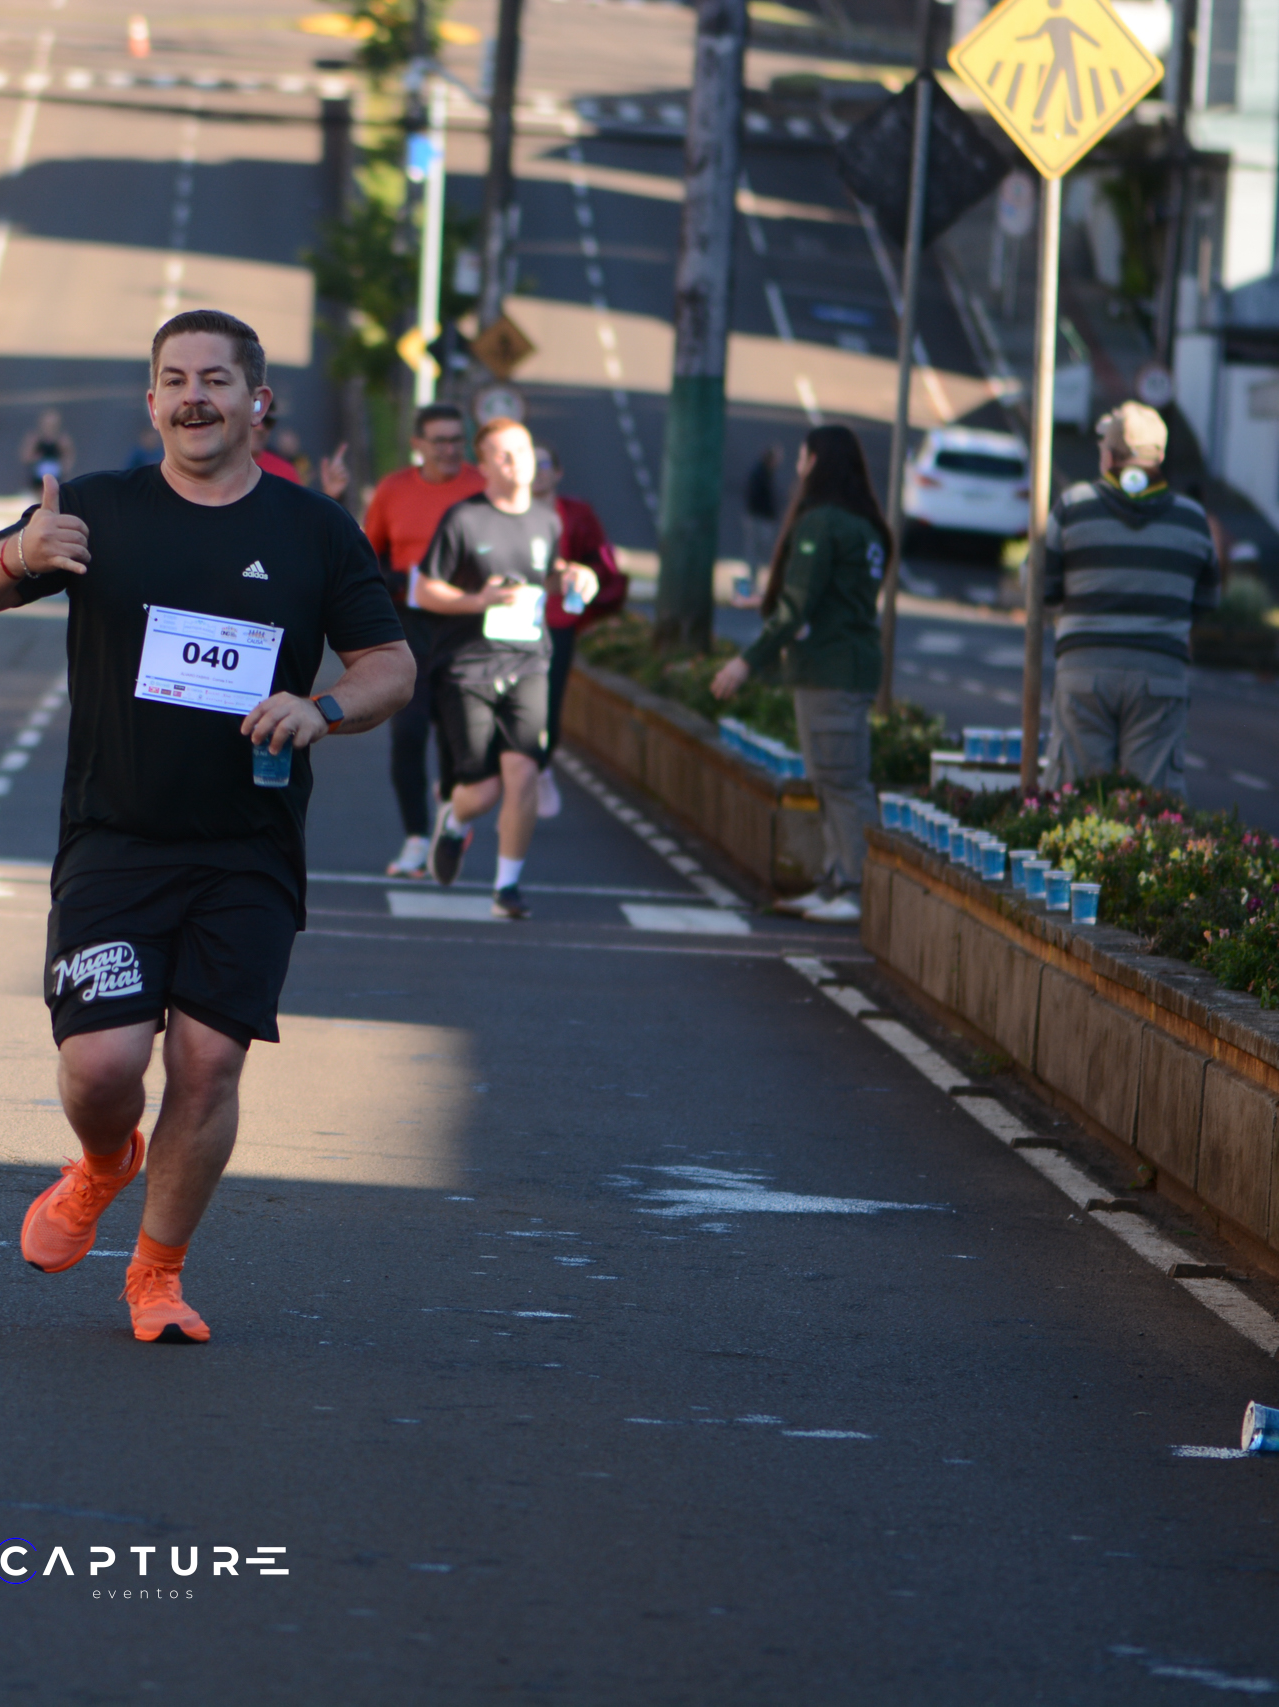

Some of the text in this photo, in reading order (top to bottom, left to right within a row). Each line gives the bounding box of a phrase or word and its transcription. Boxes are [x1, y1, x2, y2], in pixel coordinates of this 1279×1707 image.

[182, 641, 240, 671] 040
[53, 941, 135, 996] Muay
[74, 960, 143, 1001] Thai
